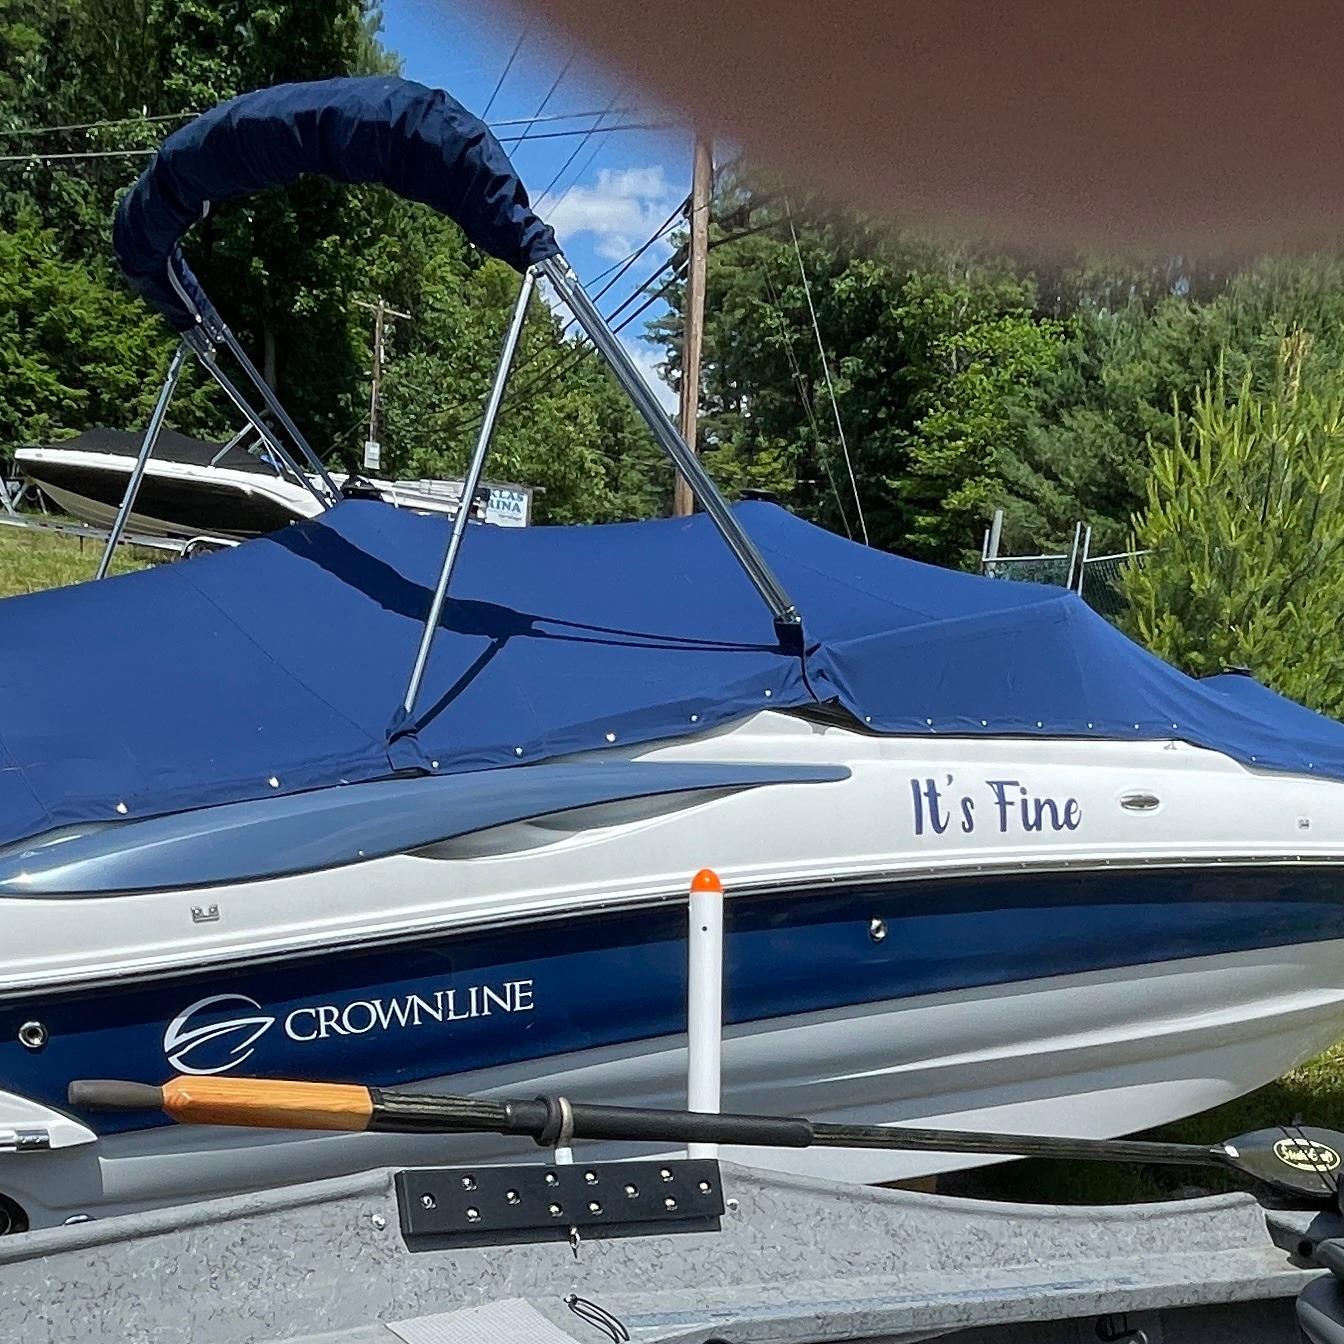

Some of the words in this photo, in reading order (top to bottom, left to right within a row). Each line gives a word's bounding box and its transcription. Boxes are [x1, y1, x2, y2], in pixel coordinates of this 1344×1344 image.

[910, 773, 974, 836] It's
[984, 780, 1082, 833] Fine
[284, 979, 535, 1042] CROWNLINE
